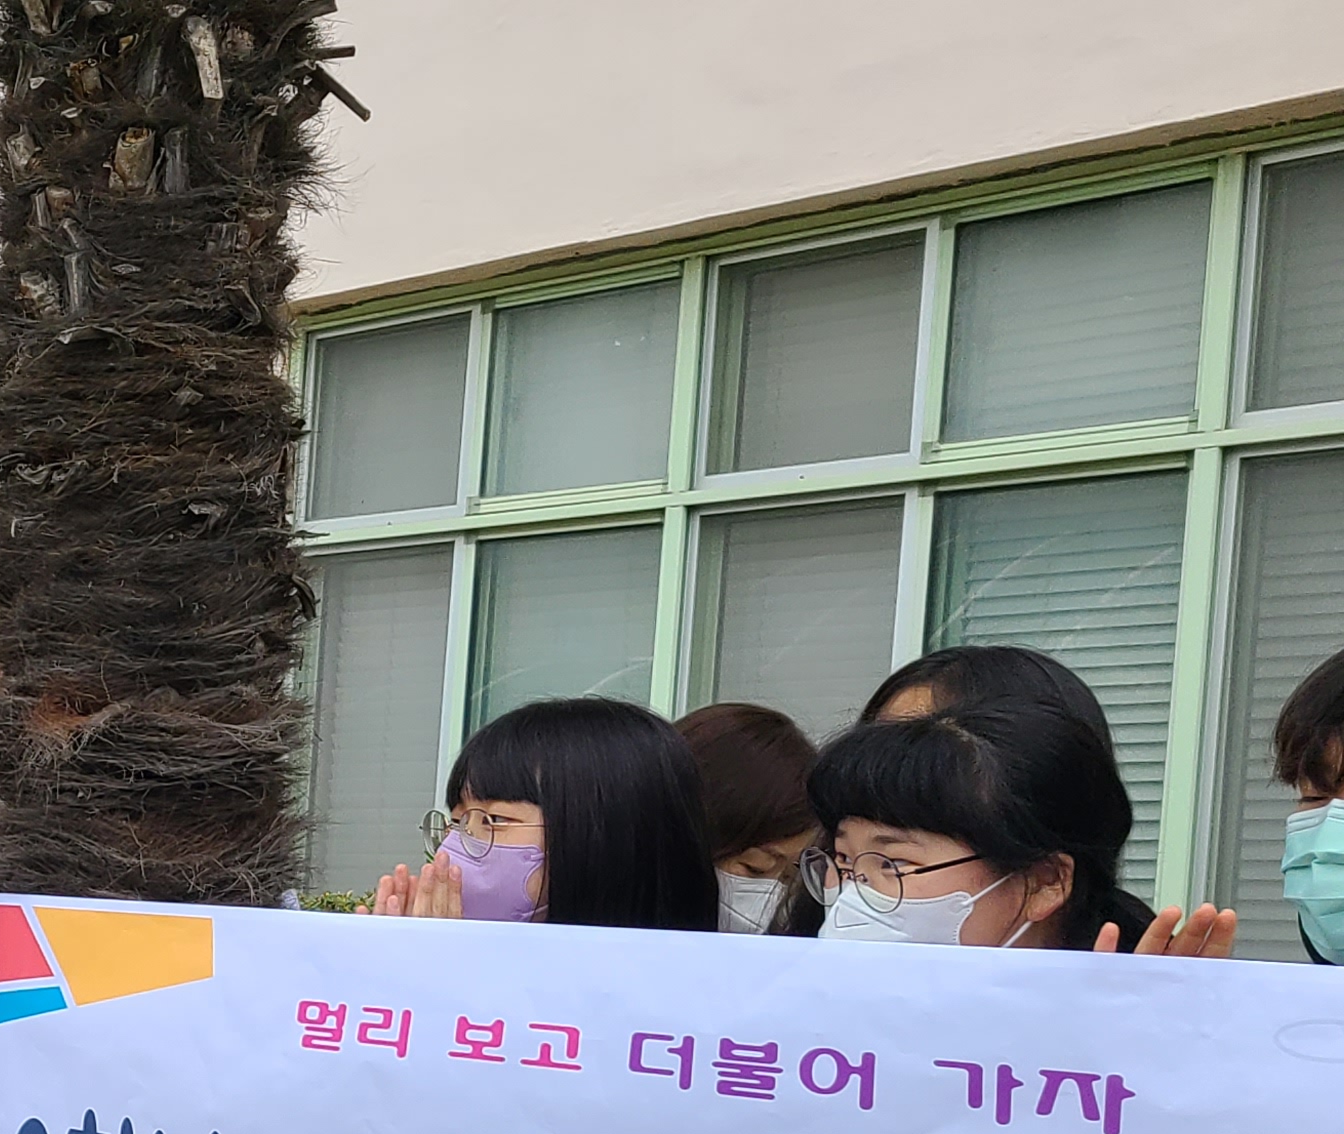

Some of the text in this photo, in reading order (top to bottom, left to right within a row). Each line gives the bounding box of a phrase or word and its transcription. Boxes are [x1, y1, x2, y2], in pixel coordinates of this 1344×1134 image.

[296, 1000, 413, 1059] 멀리
[448, 1015, 583, 1072] 보고
[628, 1031, 877, 1111] 더불어
